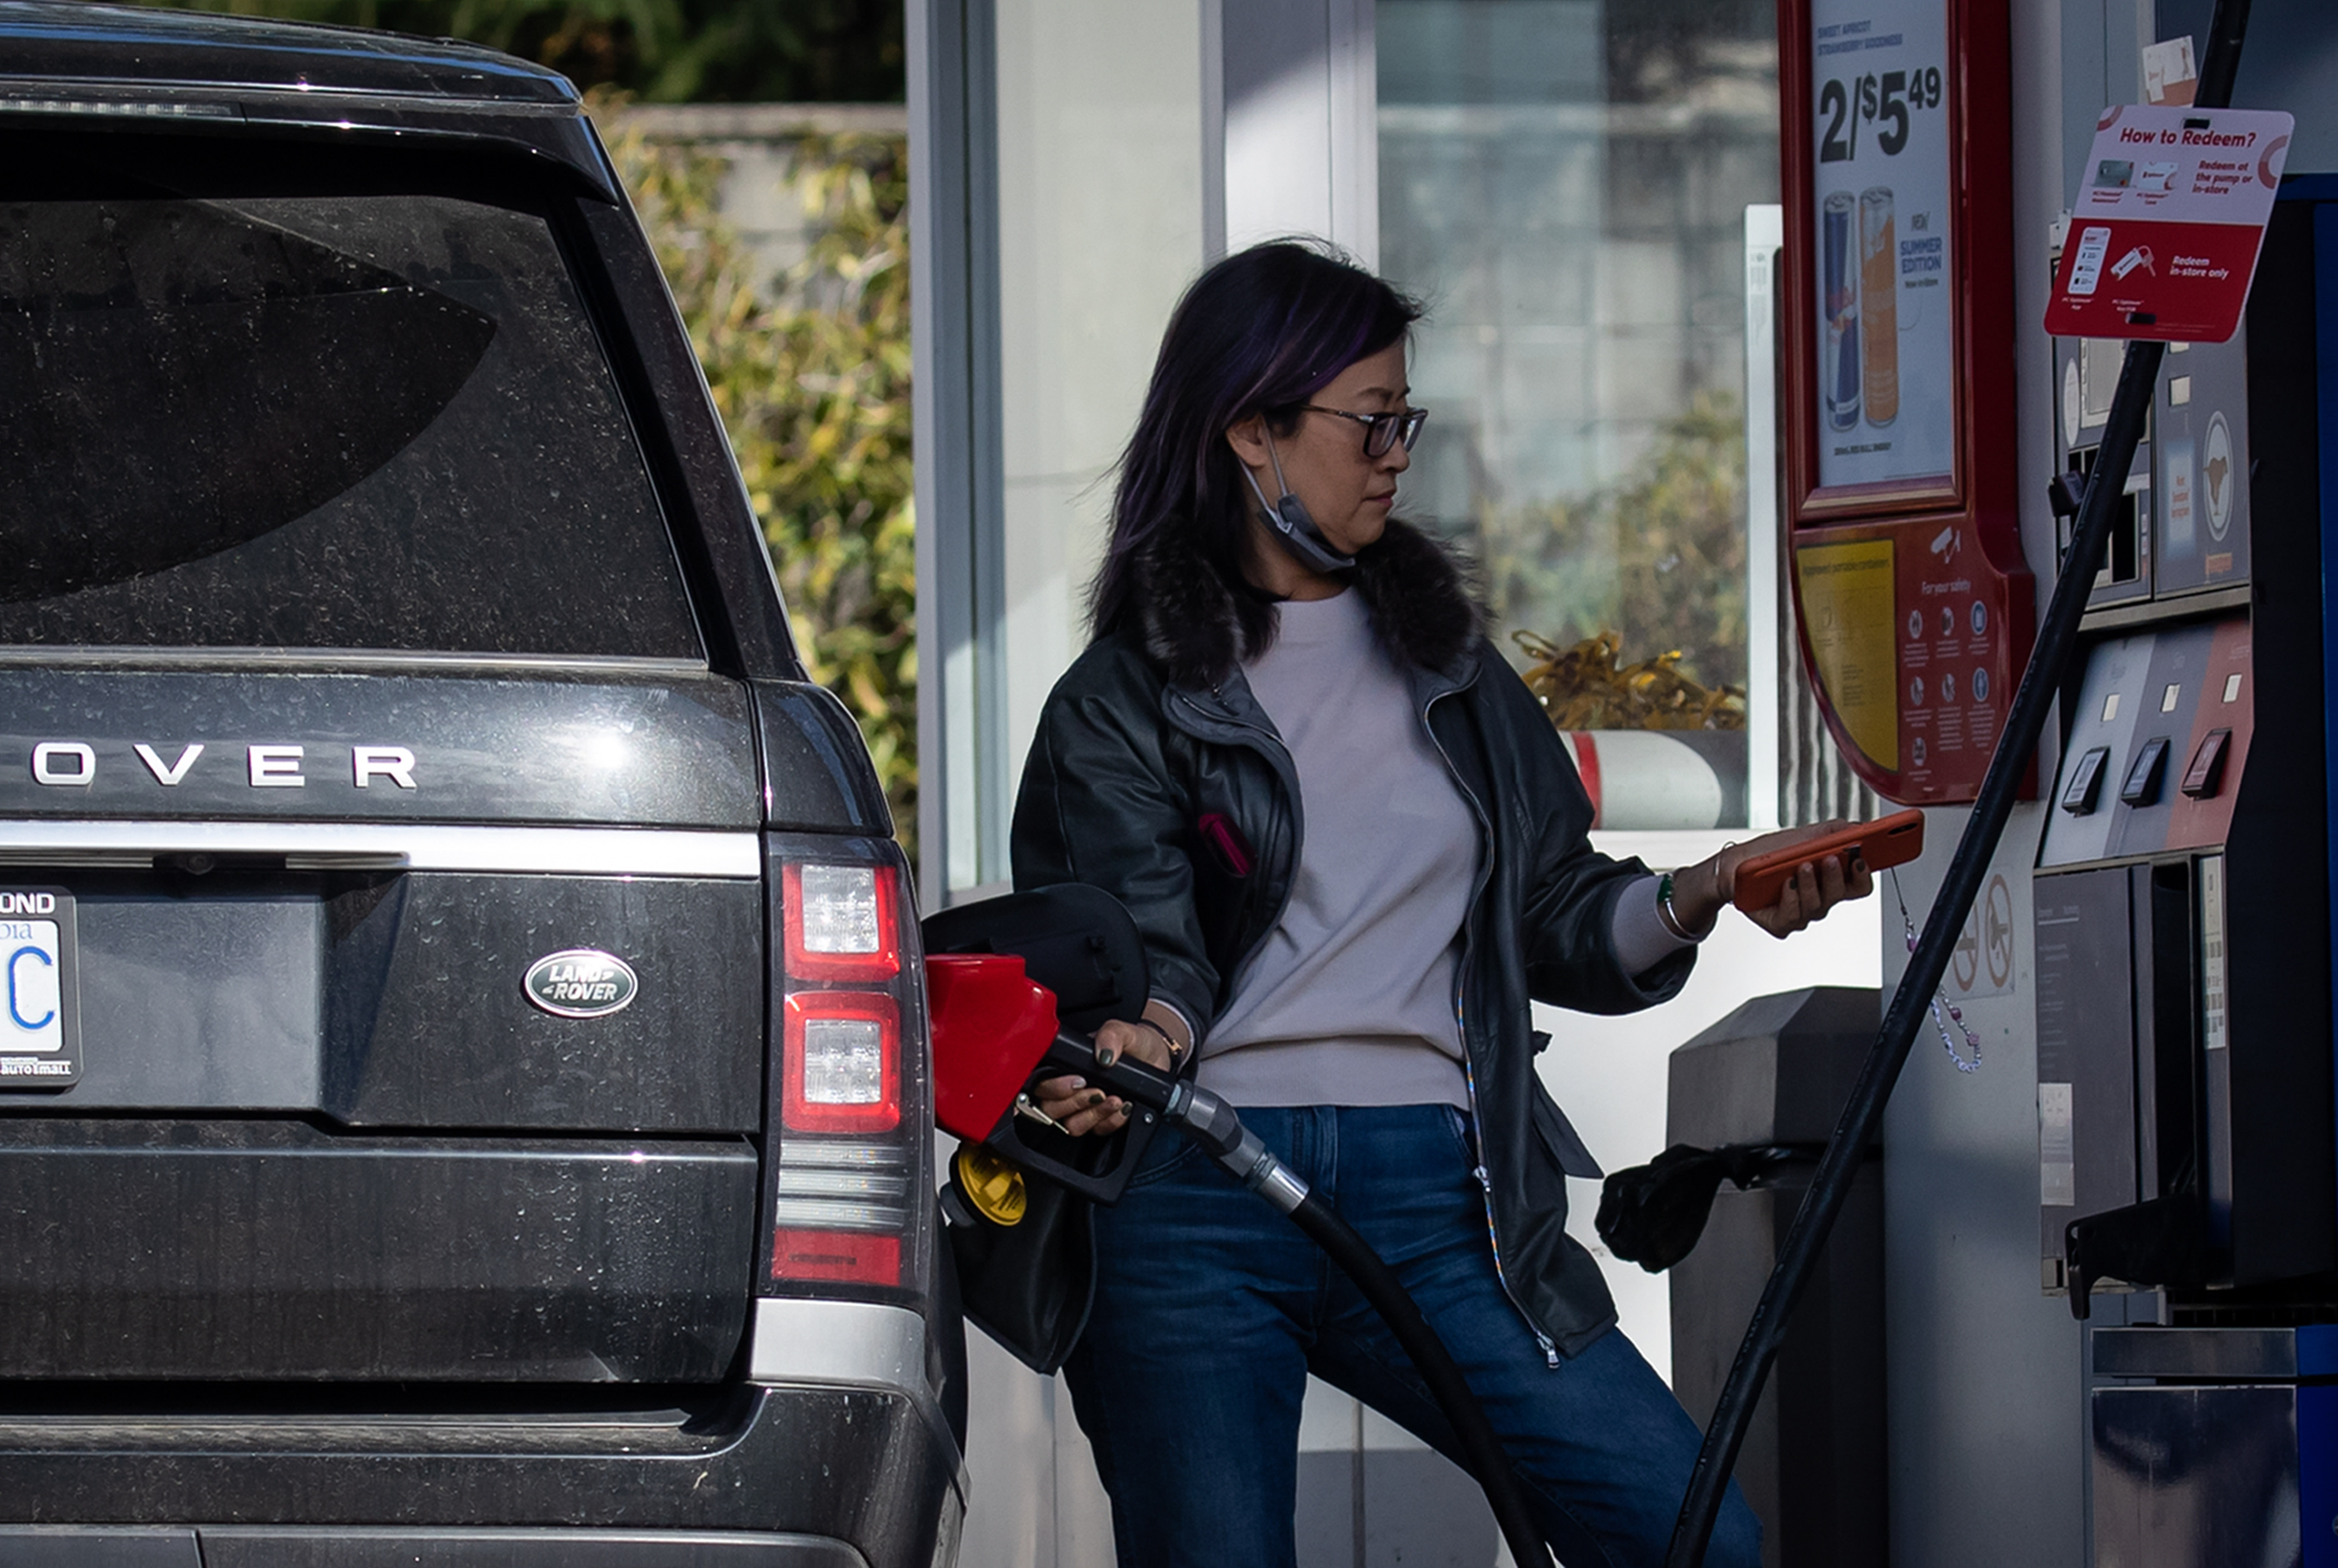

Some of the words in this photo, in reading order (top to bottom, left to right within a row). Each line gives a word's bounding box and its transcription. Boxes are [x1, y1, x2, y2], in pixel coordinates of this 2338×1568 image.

[2120, 128, 2156, 144] How
[2160, 129, 2177, 144] to
[2182, 130, 2256, 148] Redeem?
[2198, 160, 2236, 171] Redeem
[2238, 162, 2248, 171] at
[2192, 183, 2229, 194] in-store
[2196, 172, 2211, 182] the
[2213, 175, 2240, 186] pump
[1901, 237, 1942, 256] SUMMER
[1902, 255, 1941, 274] EDITION
[2172, 255, 2210, 266] Redeem
[32, 742, 417, 789] OVER
[548, 964, 602, 983] LAND
[8, 946, 55, 1029] C
[553, 983, 618, 1000] ROVER
